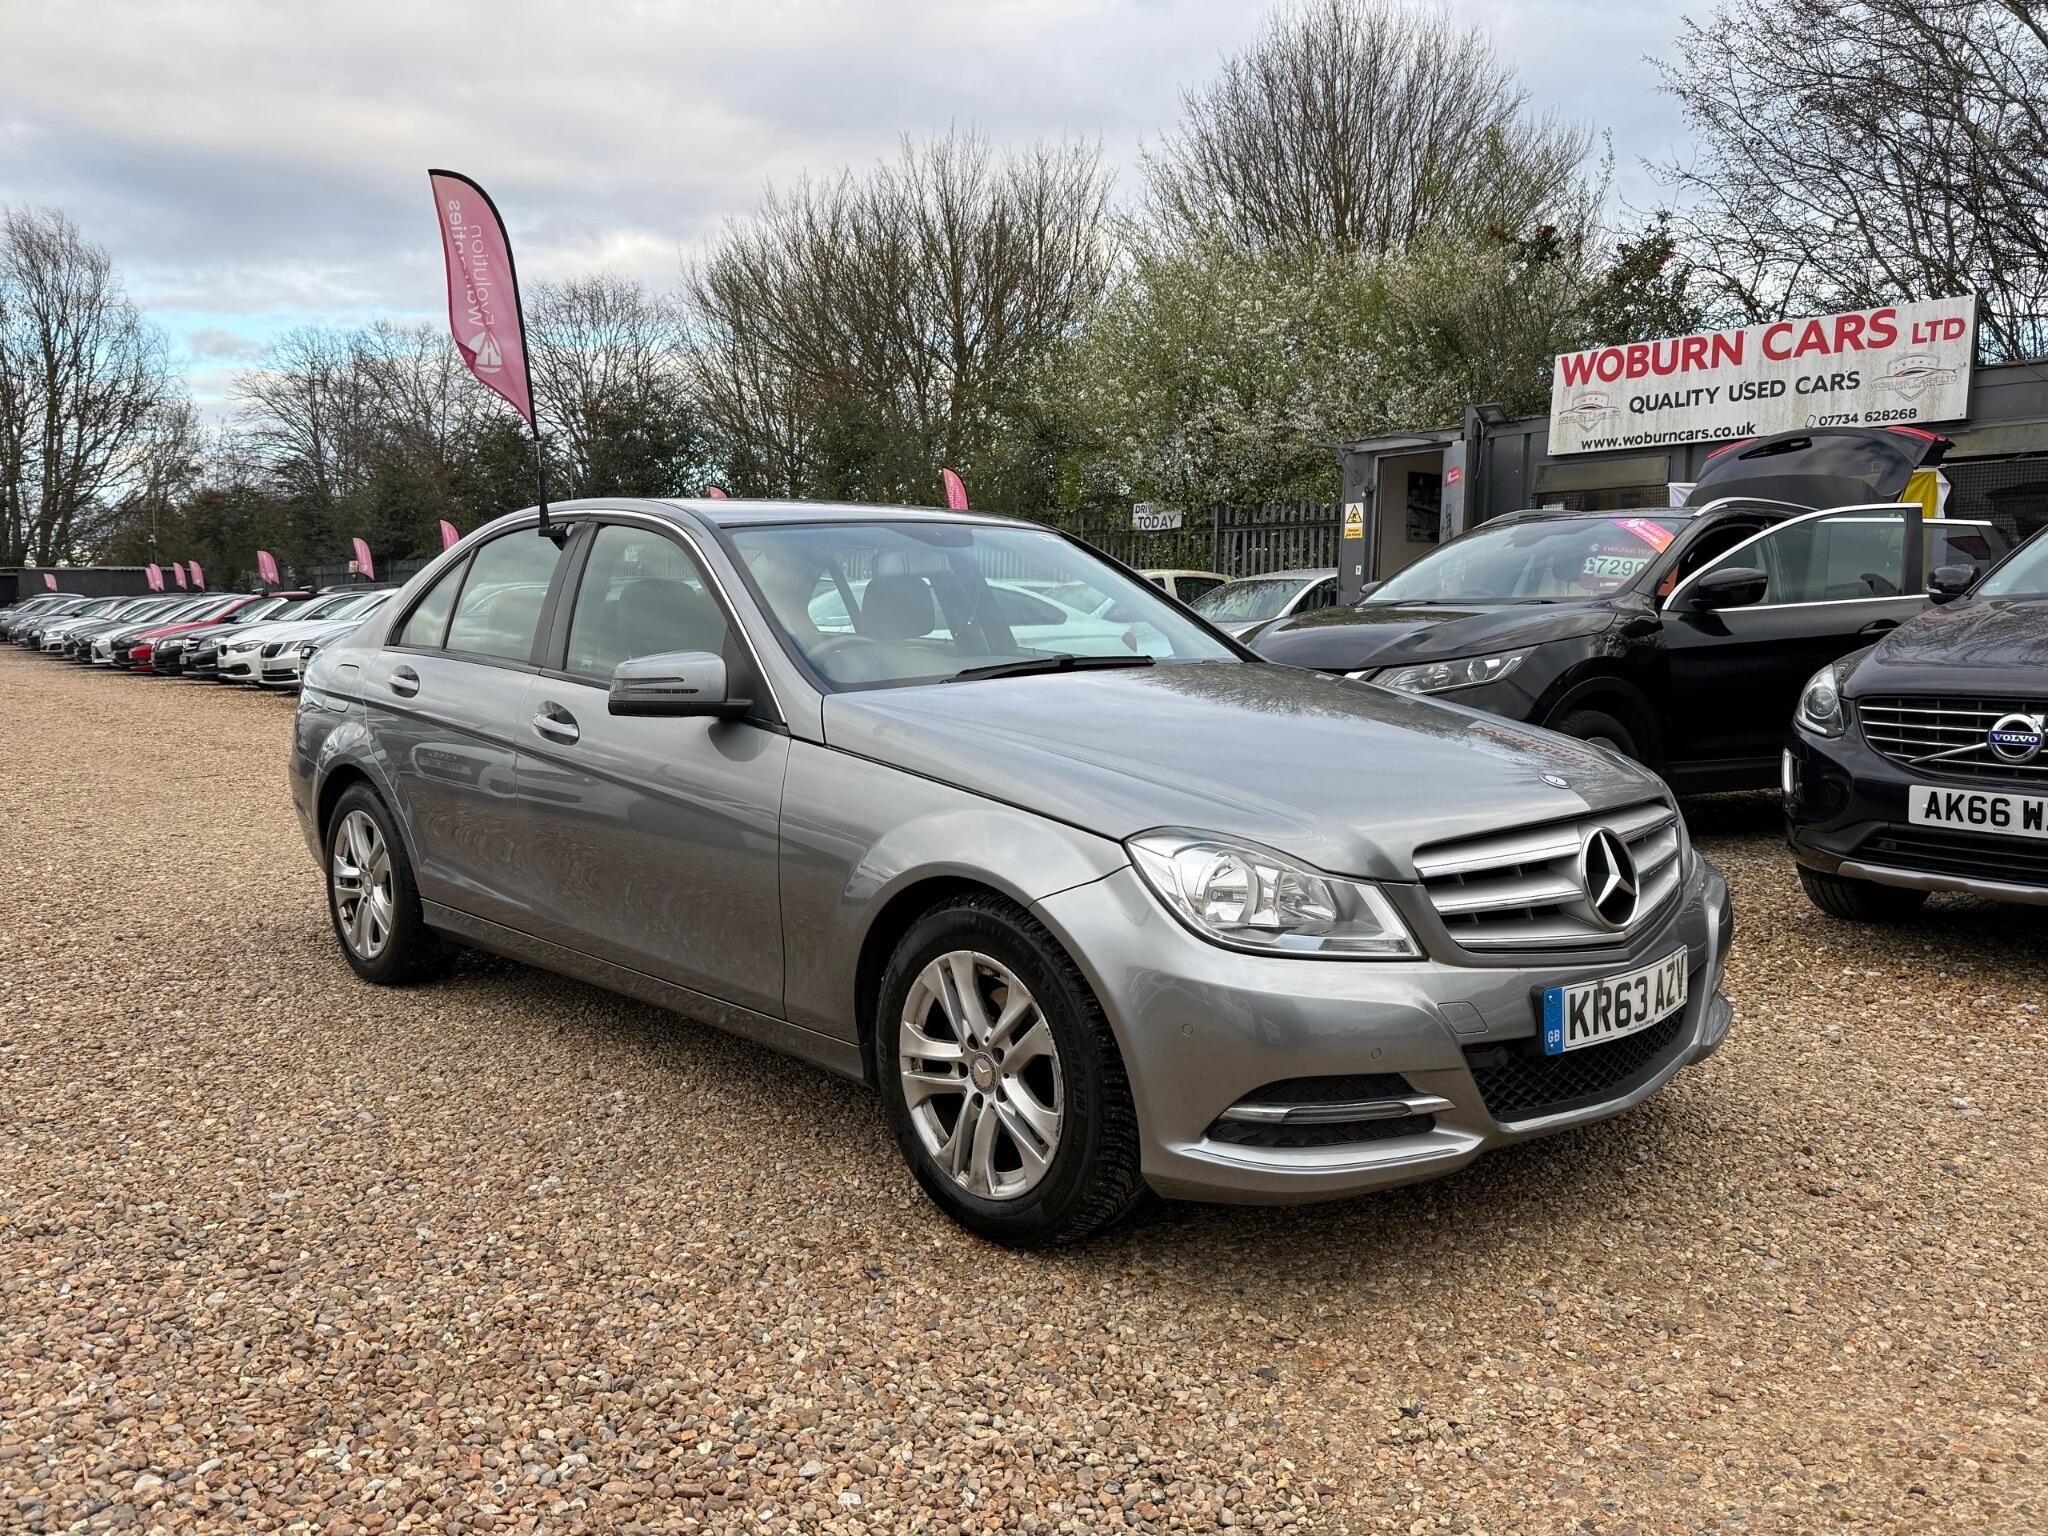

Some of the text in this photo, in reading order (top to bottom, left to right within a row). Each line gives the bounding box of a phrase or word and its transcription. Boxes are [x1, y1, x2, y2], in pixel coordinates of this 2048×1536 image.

[1561, 308, 1966, 388] WOBURN CARS LTD
[1629, 370, 1861, 414] QUALITY USED CARS
[1818, 408, 1918, 426] 07734 628268
[1581, 421, 1757, 450] www.woburncars.co.uk
[1138, 515, 1177, 529] TODAY
[1992, 733, 2038, 744] VOLVO
[1924, 791, 2048, 831] AK66 W
[1569, 954, 1686, 1041] KR63 AZV
[1548, 1029, 1560, 1043] GB
